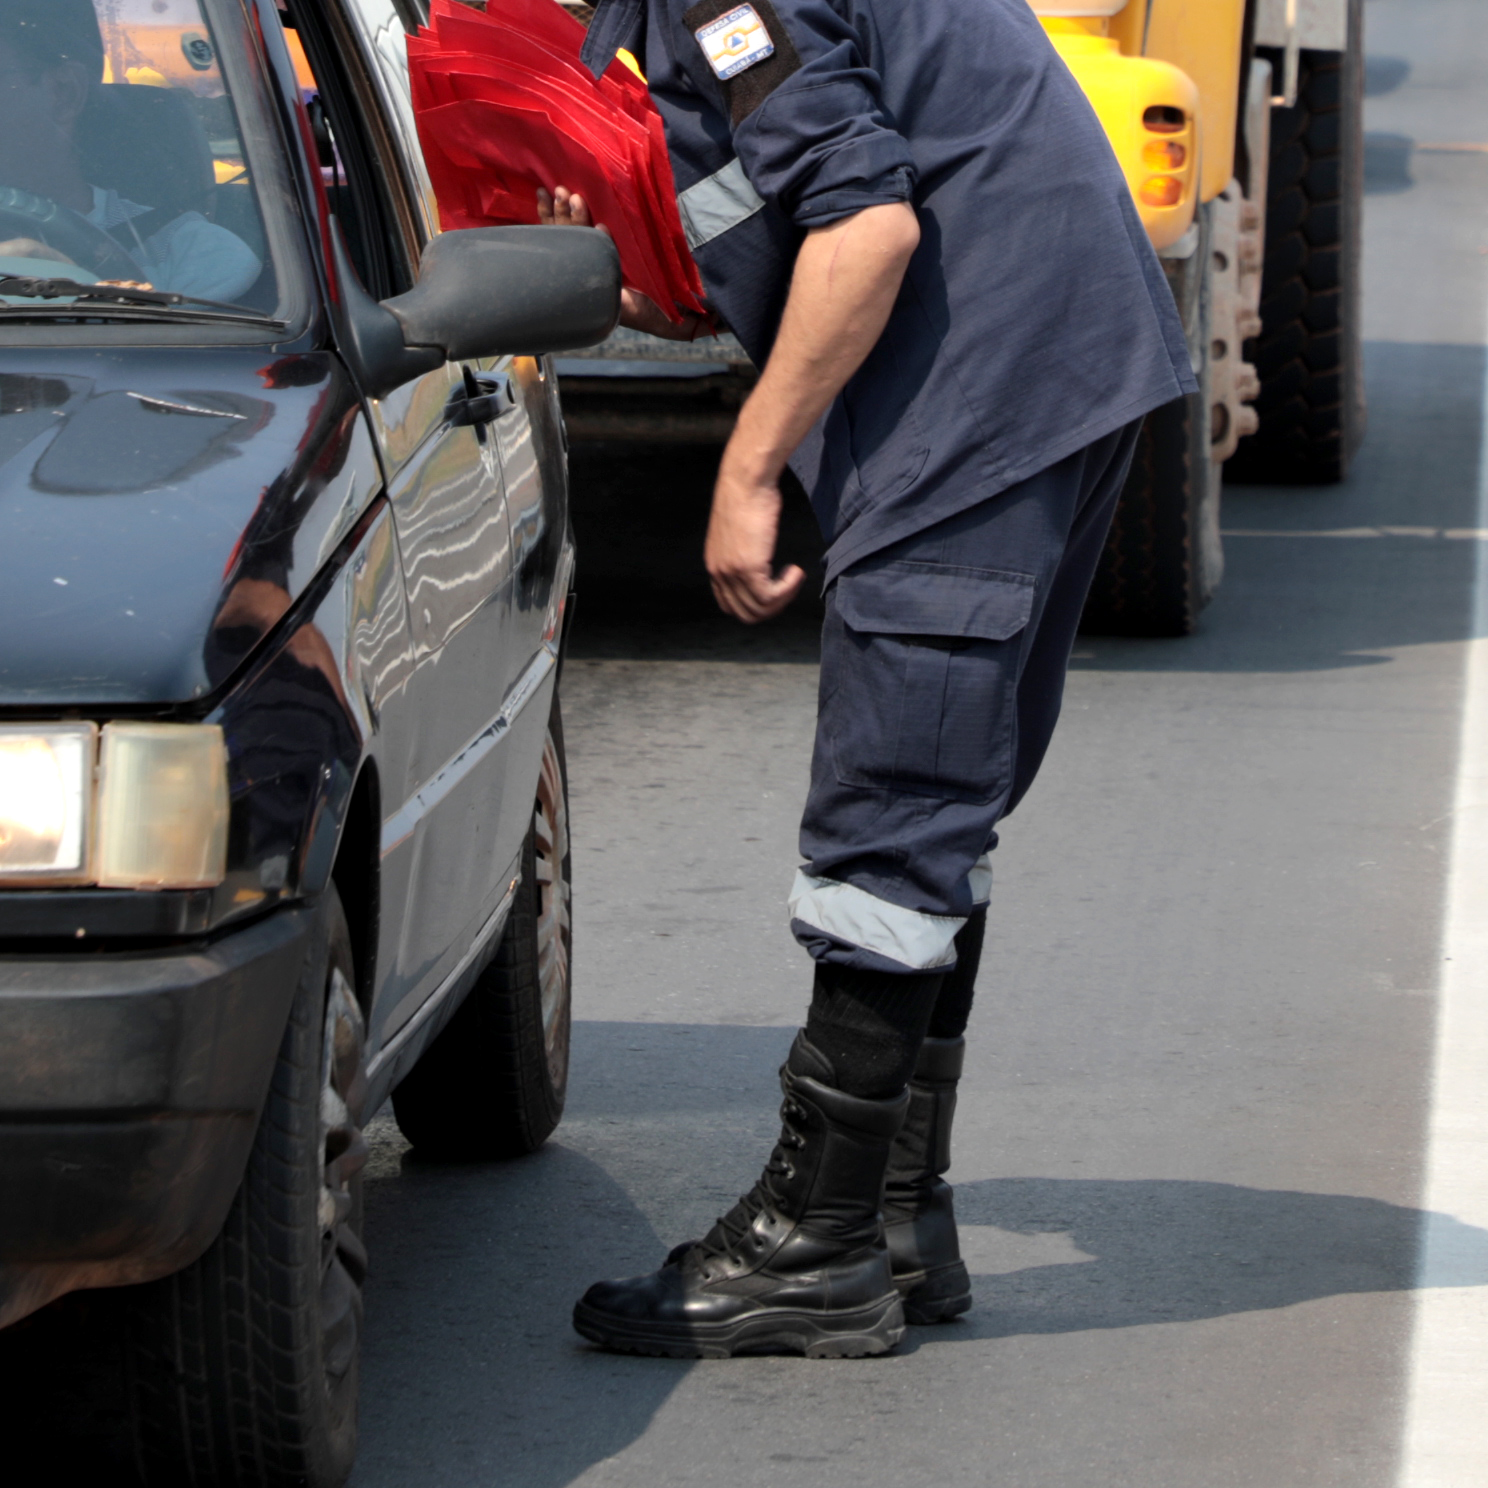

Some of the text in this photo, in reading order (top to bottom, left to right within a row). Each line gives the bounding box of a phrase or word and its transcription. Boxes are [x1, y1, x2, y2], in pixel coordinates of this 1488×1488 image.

[701, 7, 750, 37] DEFESA CIVIL
[756, 48, 769, 59] MT
